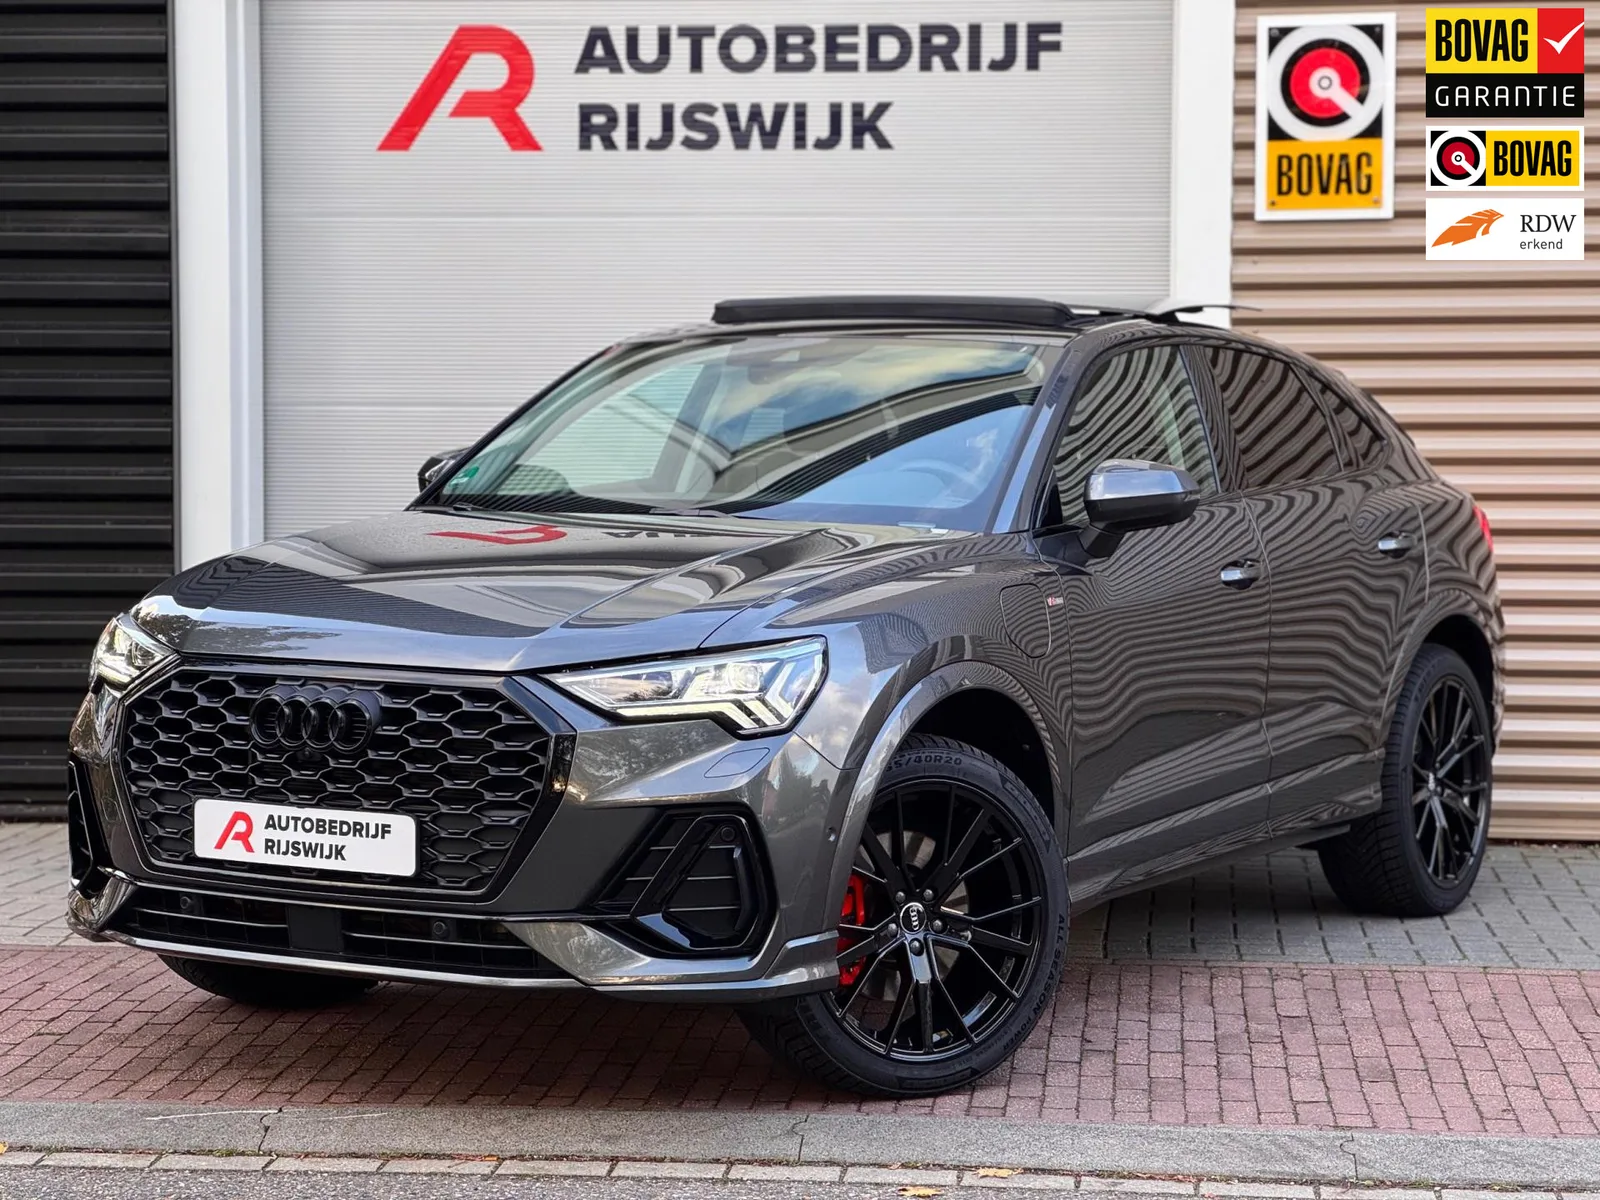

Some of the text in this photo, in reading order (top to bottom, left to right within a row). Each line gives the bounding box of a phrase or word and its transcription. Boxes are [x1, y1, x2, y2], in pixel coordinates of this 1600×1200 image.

[575, 22, 1063, 74] AUTOBEDRIJF
[578, 102, 894, 151] RIJSWIJK
[1277, 152, 1372, 197] BOVAG
[264, 814, 392, 840] AUTOBEDRIJF
[264, 838, 347, 861] RIJSWIJK
[1053, 913, 1066, 944] ALL
[1033, 948, 1062, 1016] SEASON
